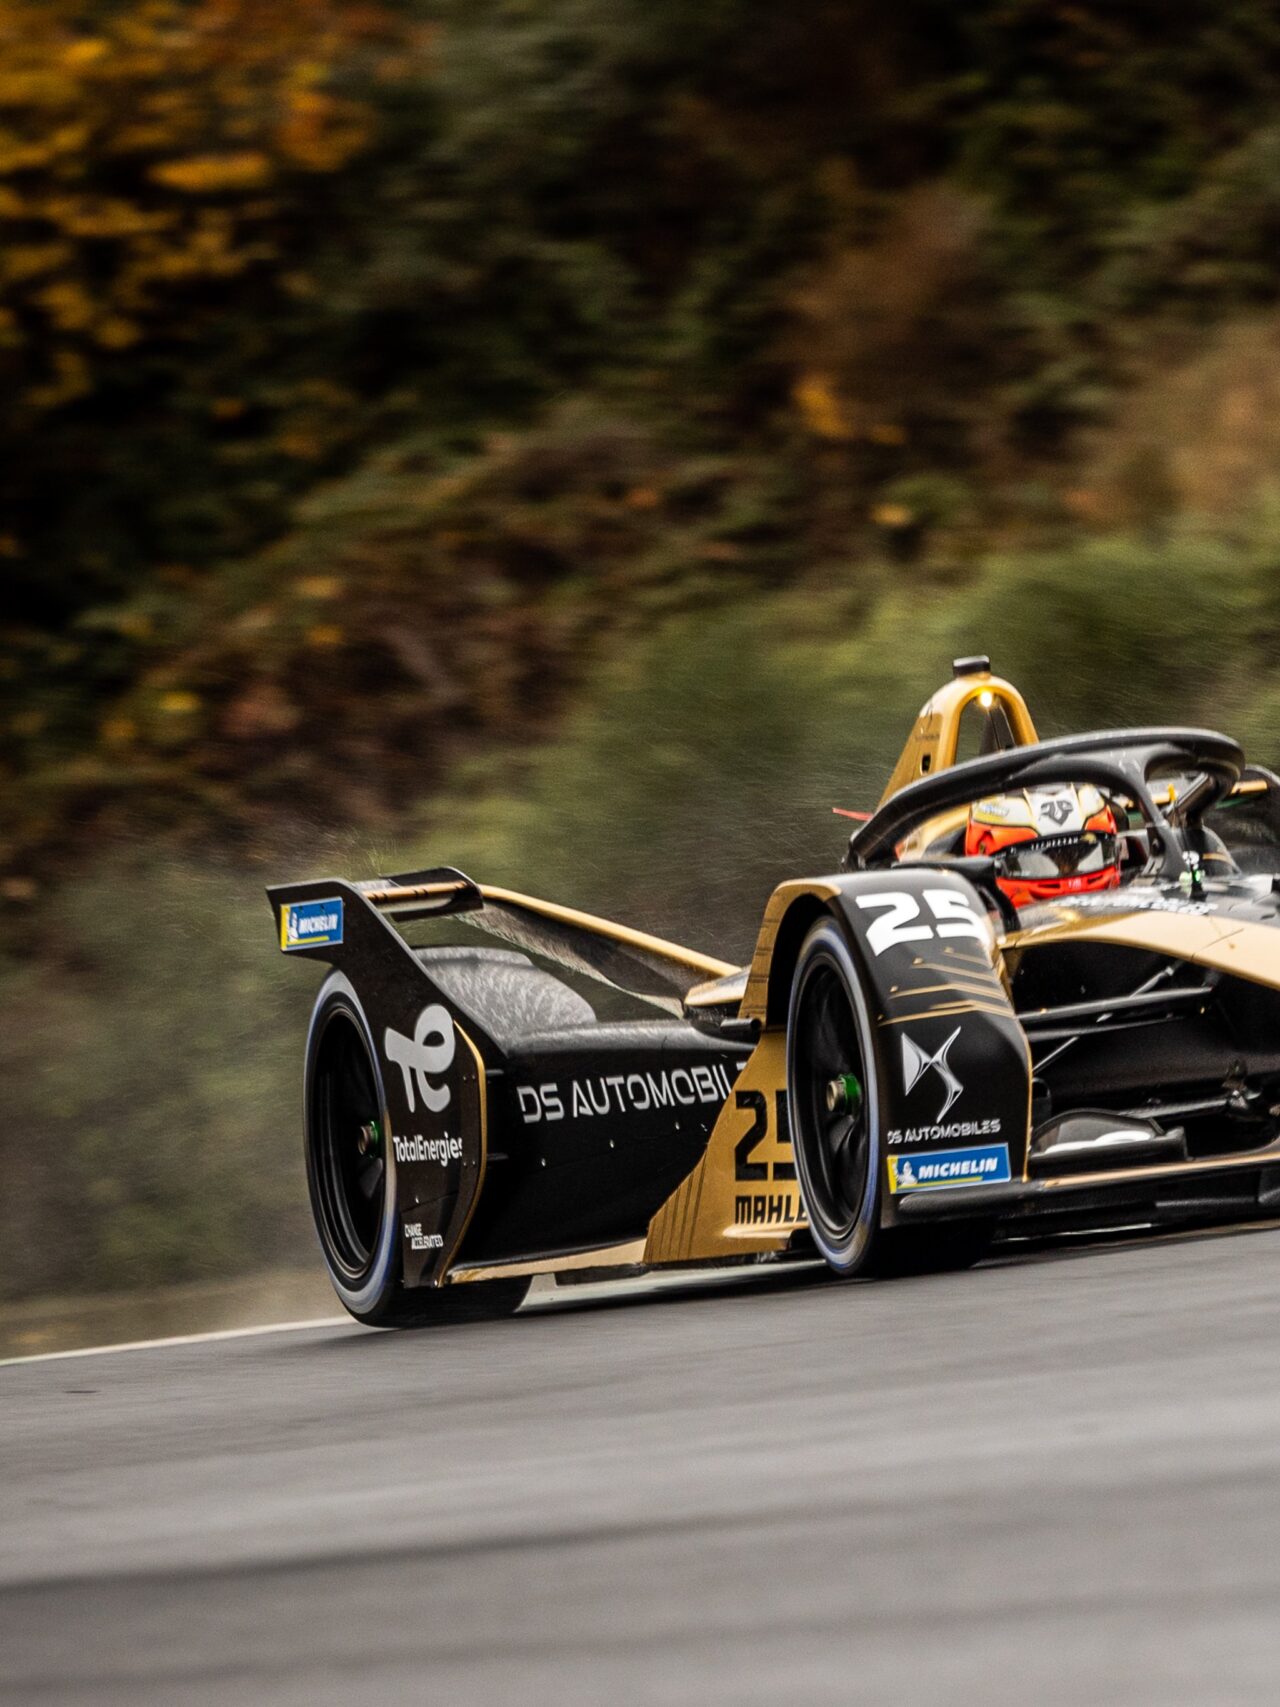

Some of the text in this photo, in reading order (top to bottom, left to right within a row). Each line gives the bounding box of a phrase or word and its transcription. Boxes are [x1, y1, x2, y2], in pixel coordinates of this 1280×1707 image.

[855, 889, 991, 957] 25
[516, 1061, 747, 1124] DS AUTOMOBIL
[904, 1118, 1001, 1143] AUTOMOBILES
[918, 1157, 999, 1180] MICHELIN
